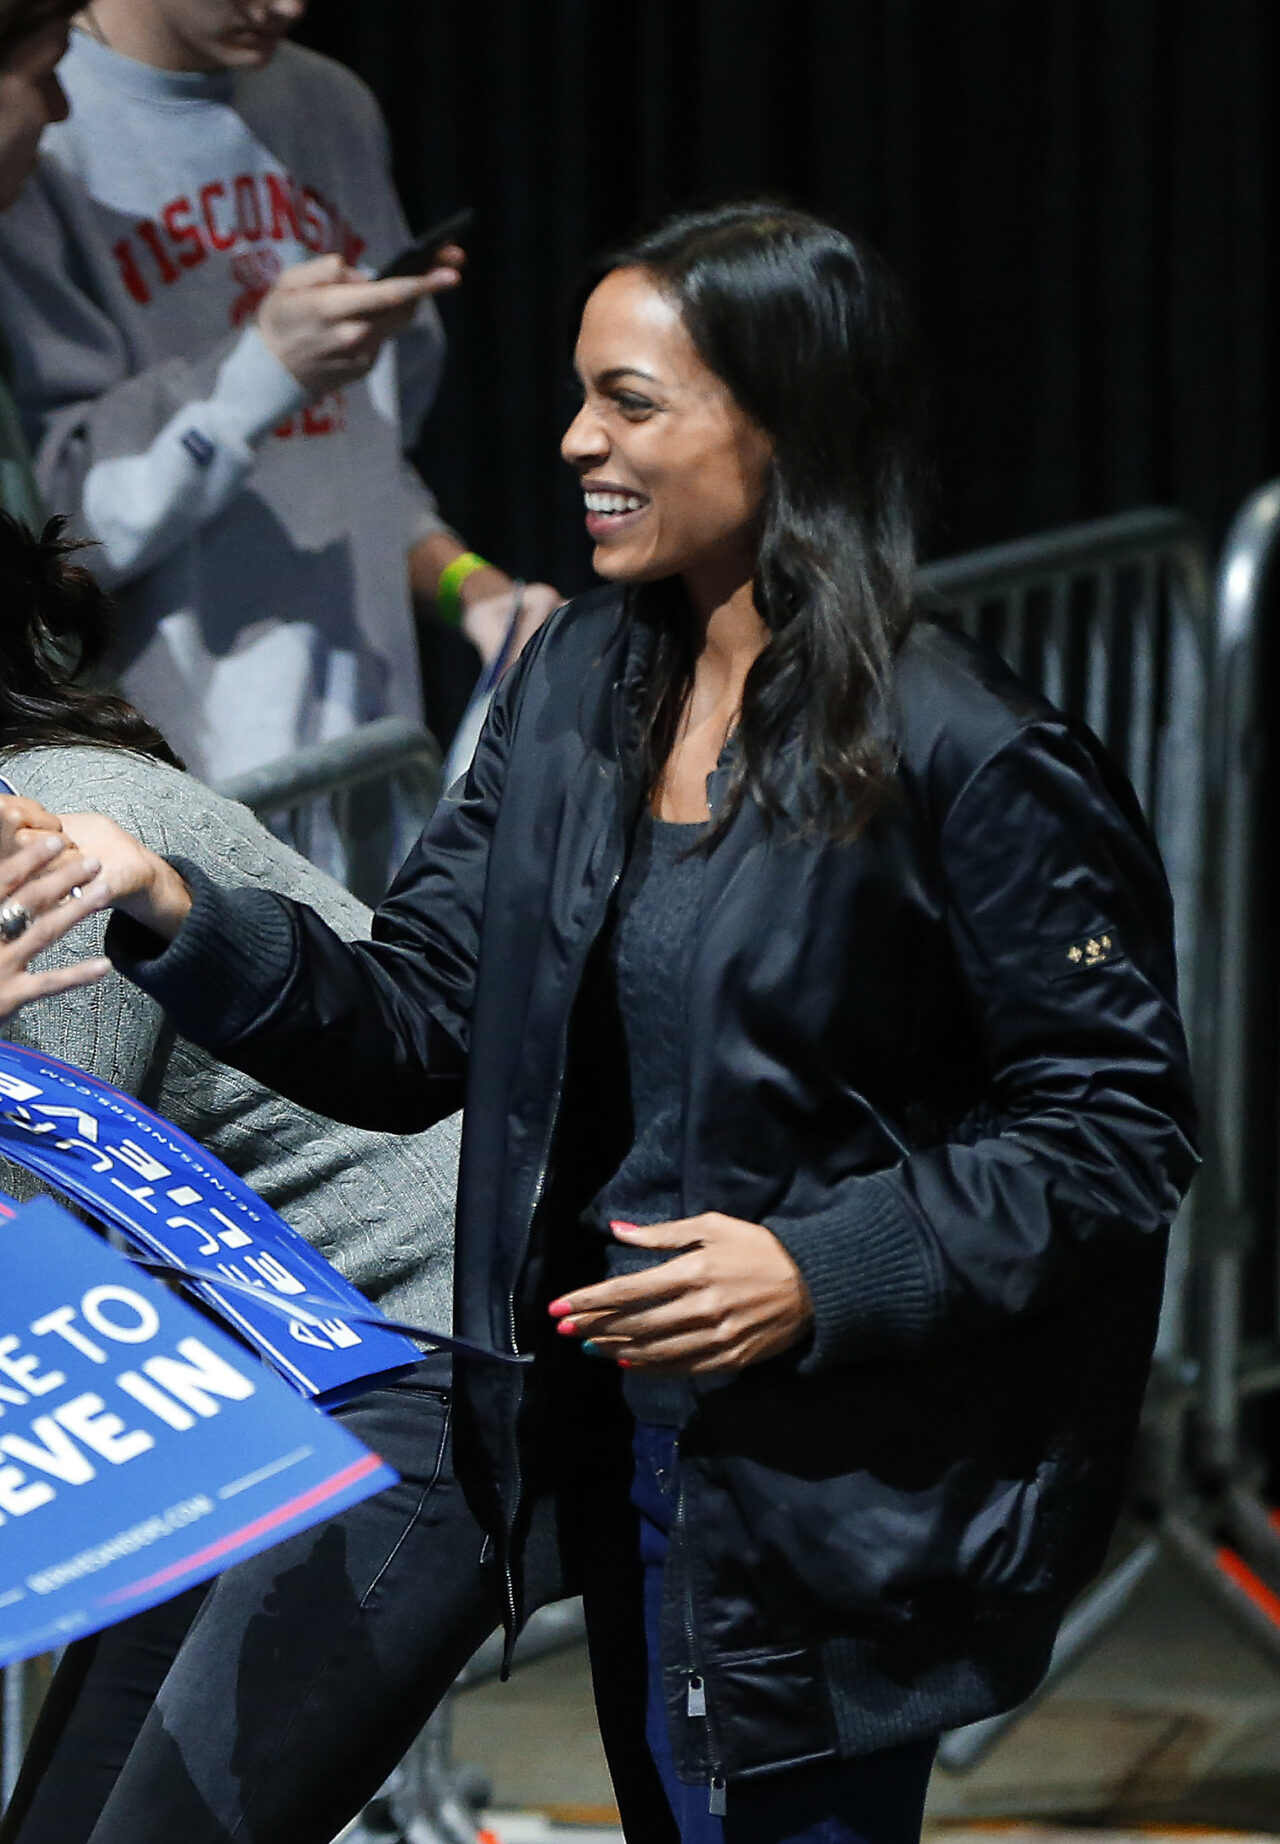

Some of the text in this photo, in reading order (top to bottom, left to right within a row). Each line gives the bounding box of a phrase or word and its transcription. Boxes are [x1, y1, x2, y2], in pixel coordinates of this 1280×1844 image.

[39, 1067, 261, 1222] BERNIESANDERS.COM
[30, 1284, 160, 1364] TO
[116, 1336, 255, 1431] IN
